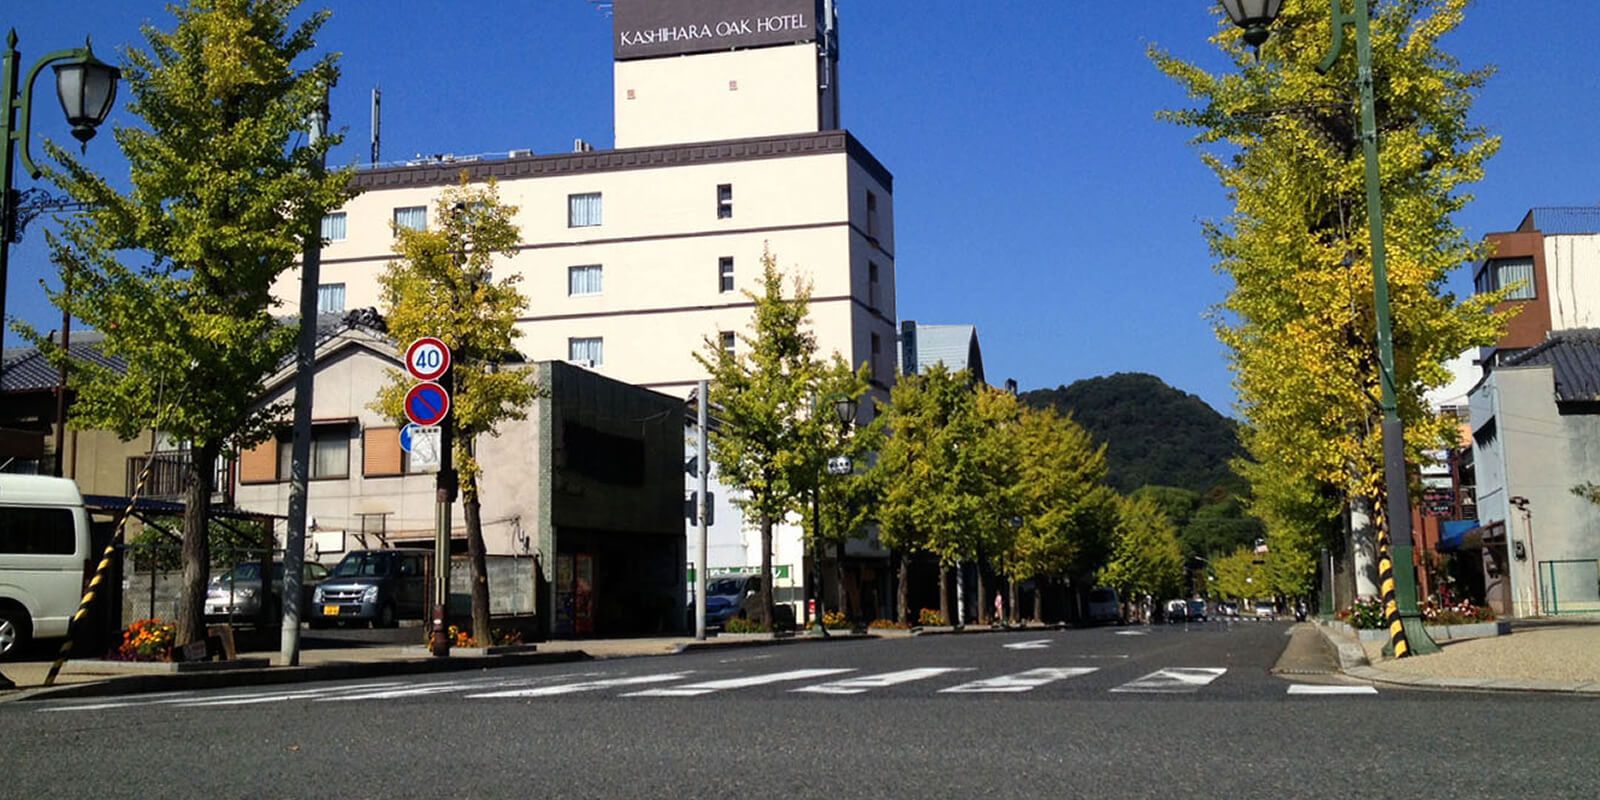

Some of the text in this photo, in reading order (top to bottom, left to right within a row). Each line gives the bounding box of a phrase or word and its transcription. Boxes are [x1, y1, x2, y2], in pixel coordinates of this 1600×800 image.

[620, 14, 807, 46] KASHIHARA OAK HOTEL
[416, 350, 439, 368] 40
